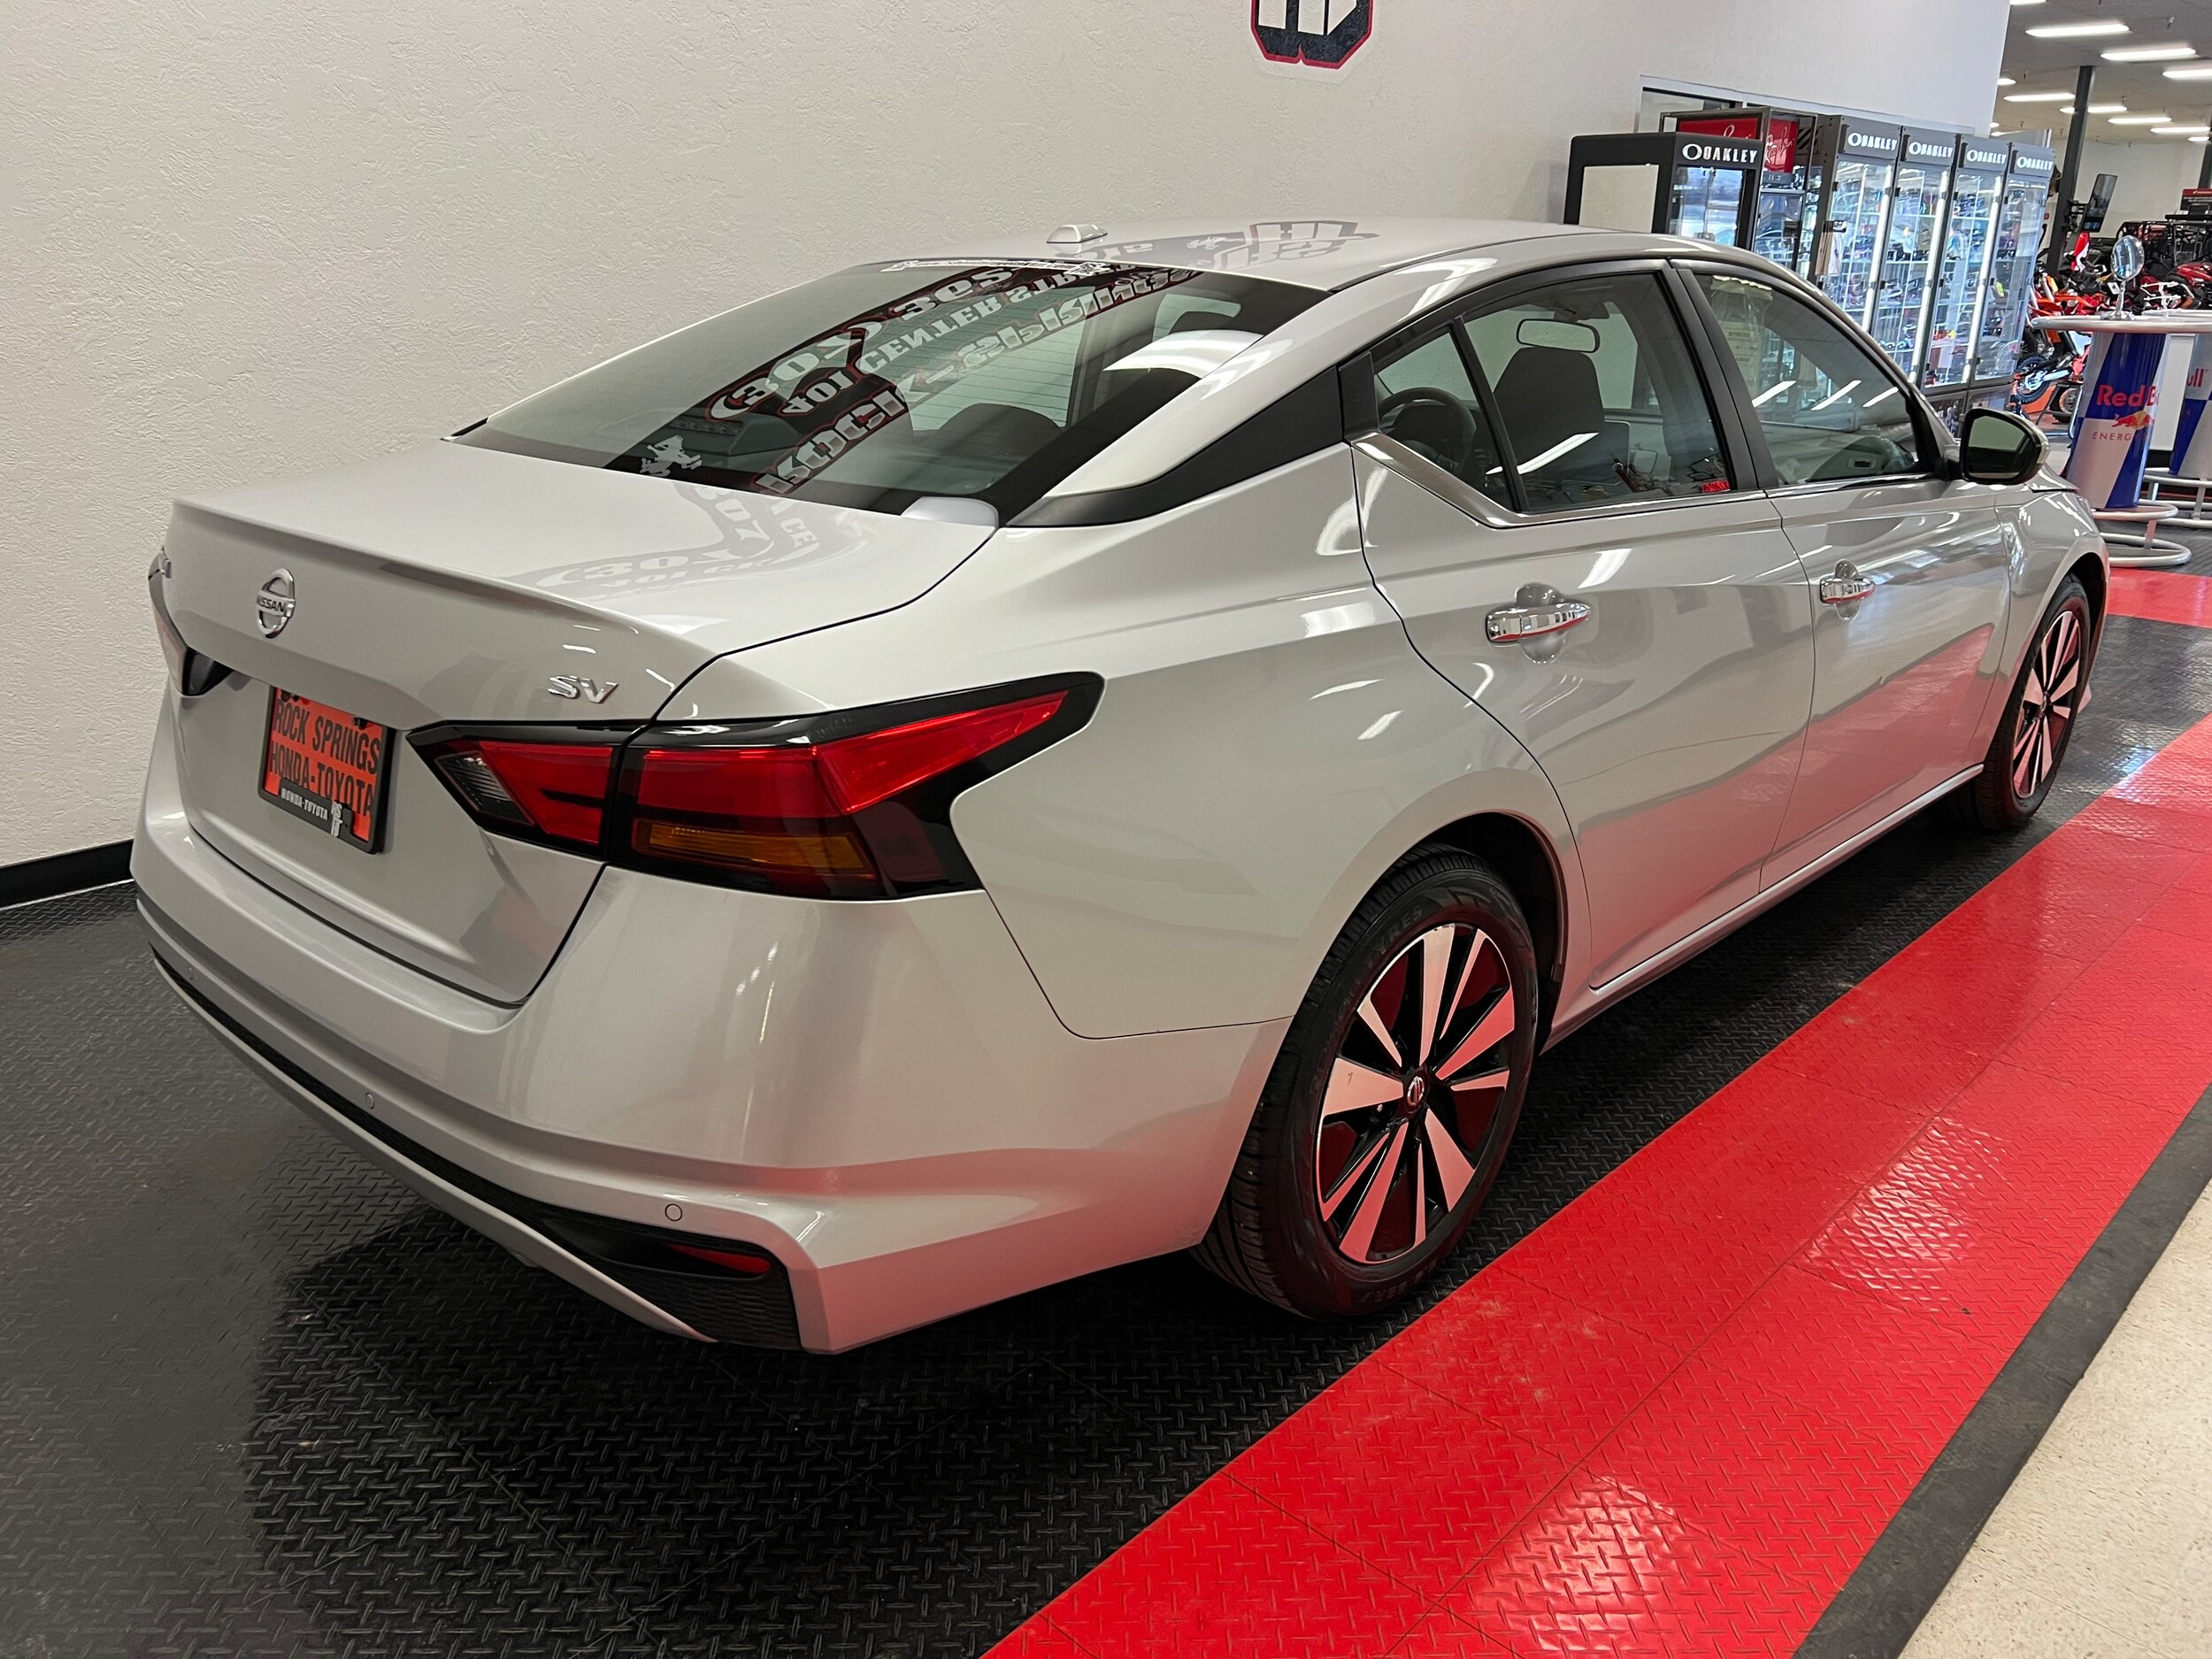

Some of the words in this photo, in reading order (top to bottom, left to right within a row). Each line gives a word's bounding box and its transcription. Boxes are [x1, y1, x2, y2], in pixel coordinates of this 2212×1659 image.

[2096, 384, 2146, 407] Red
[548, 675, 619, 703] SV
[273, 698, 310, 745] ROCK
[312, 716, 380, 774] SPRINGS
[269, 741, 375, 817] HONDA-TOYOTA
